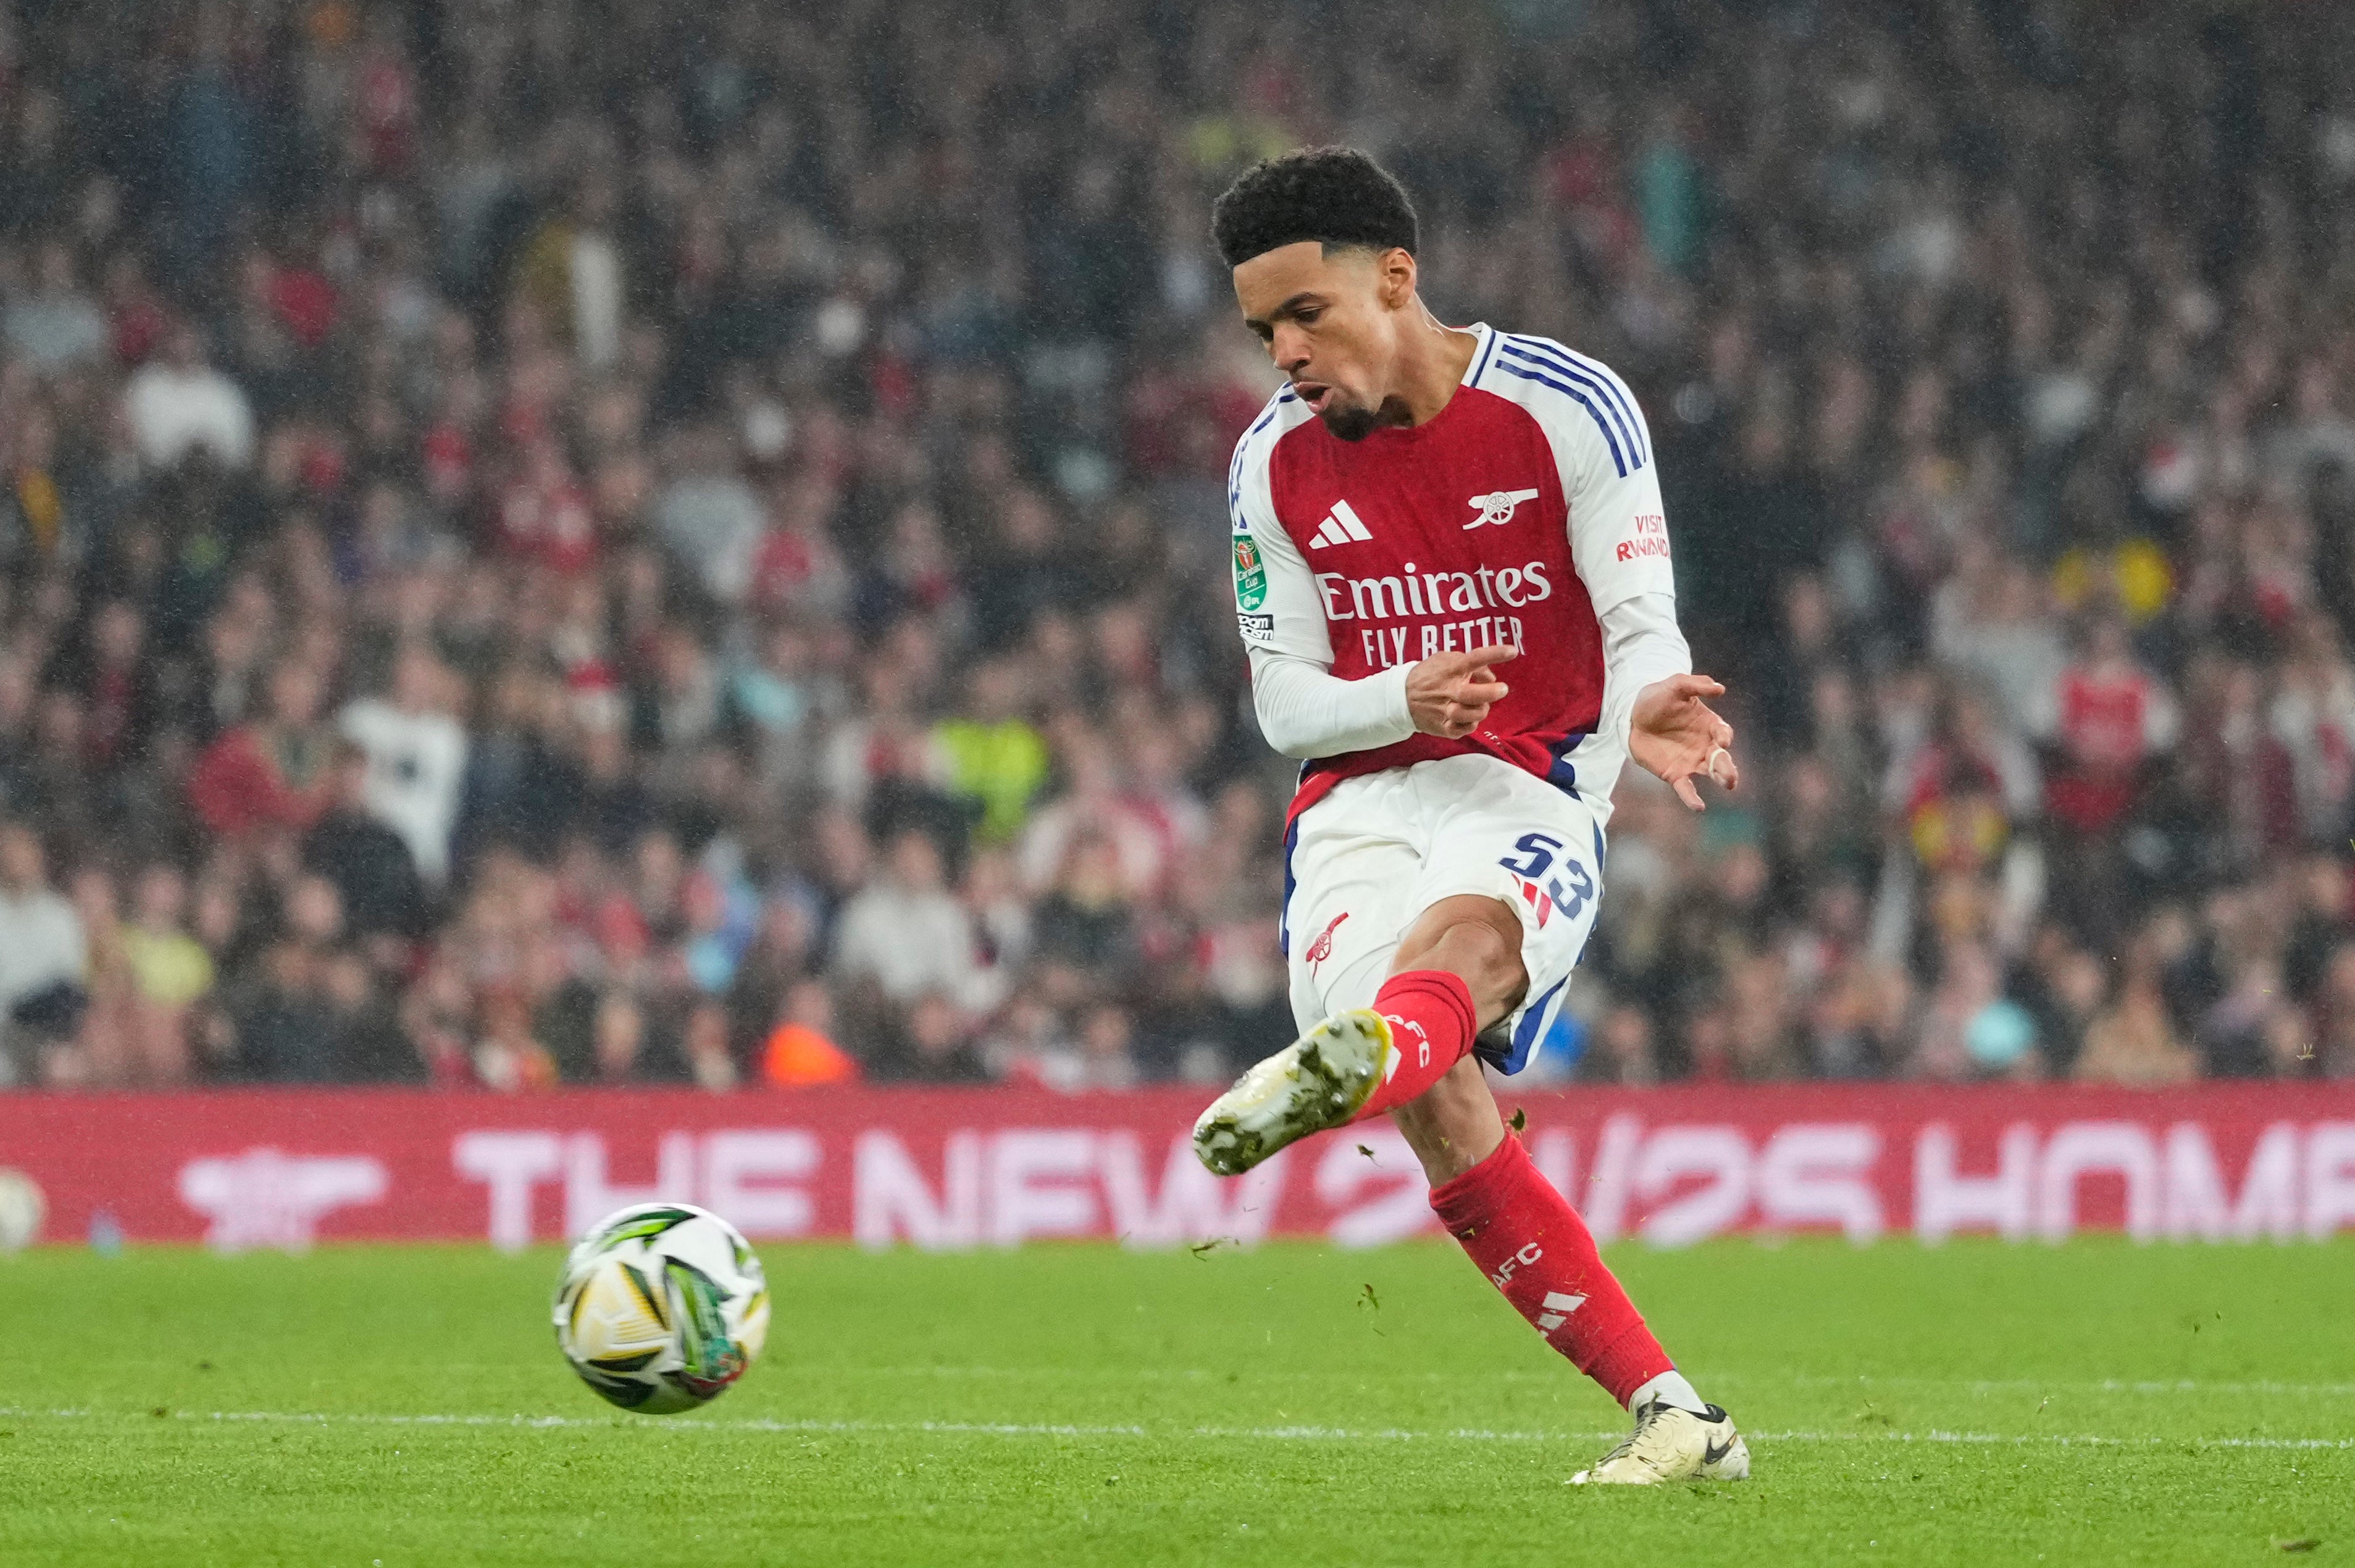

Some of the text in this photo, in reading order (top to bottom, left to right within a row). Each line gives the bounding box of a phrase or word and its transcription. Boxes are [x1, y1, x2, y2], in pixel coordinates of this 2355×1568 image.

[1616, 536, 1671, 562] RWAND
[1634, 514, 1663, 535] VISIT
[1237, 563, 1263, 582] Carabao
[1245, 576, 1258, 589] Cup
[1315, 561, 1551, 621] Emirates
[1362, 616, 1526, 668] FLY BETTER
[1497, 833, 1594, 921] 53
[1382, 1014, 1430, 1068] AFC
[454, 1128, 821, 1253] THE
[852, 1127, 1284, 1253] NEW
[1491, 1242, 1543, 1290] AFC
